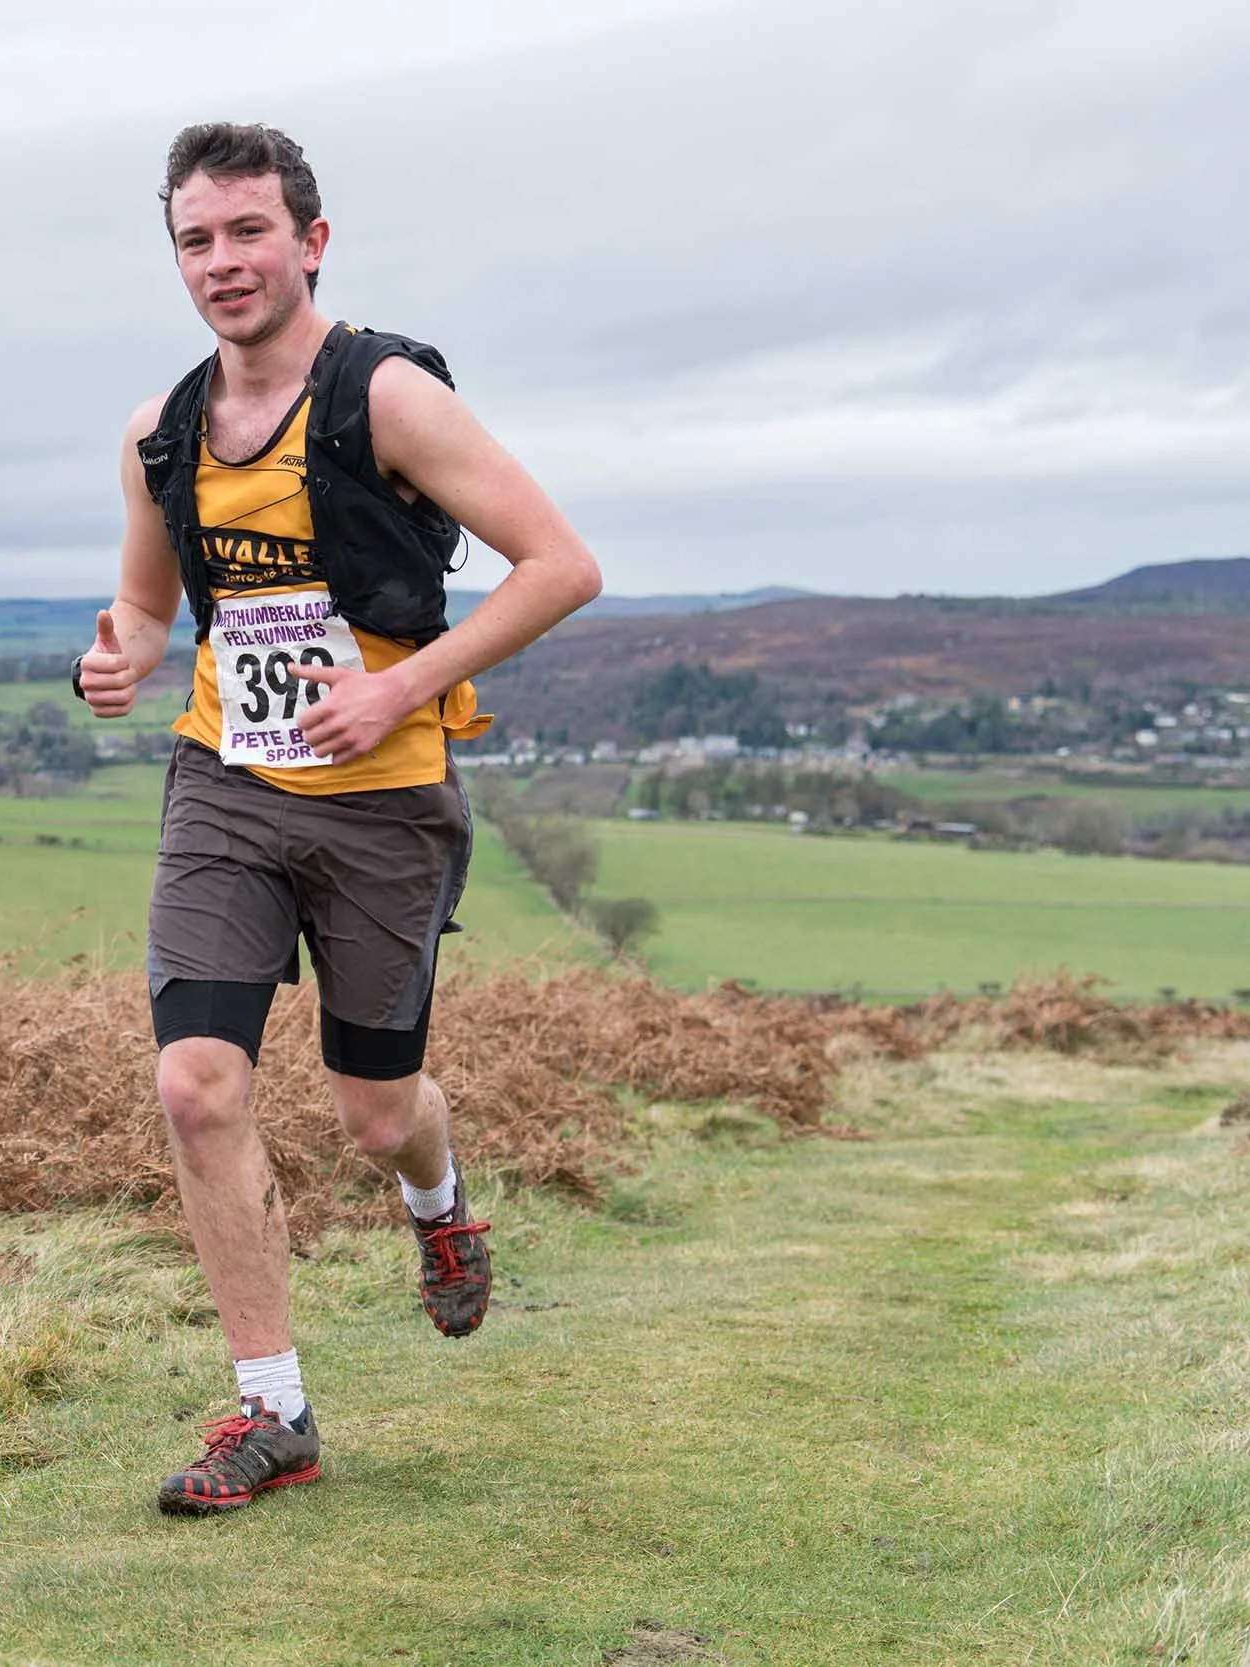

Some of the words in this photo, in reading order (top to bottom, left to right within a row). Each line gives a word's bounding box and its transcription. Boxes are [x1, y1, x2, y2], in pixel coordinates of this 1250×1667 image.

[215, 537, 311, 565] VALLE
[223, 630, 255, 647] FELL
[255, 623, 327, 646] RUNNERS
[231, 730, 284, 749] PETE
[266, 745, 312, 762] SPOR
